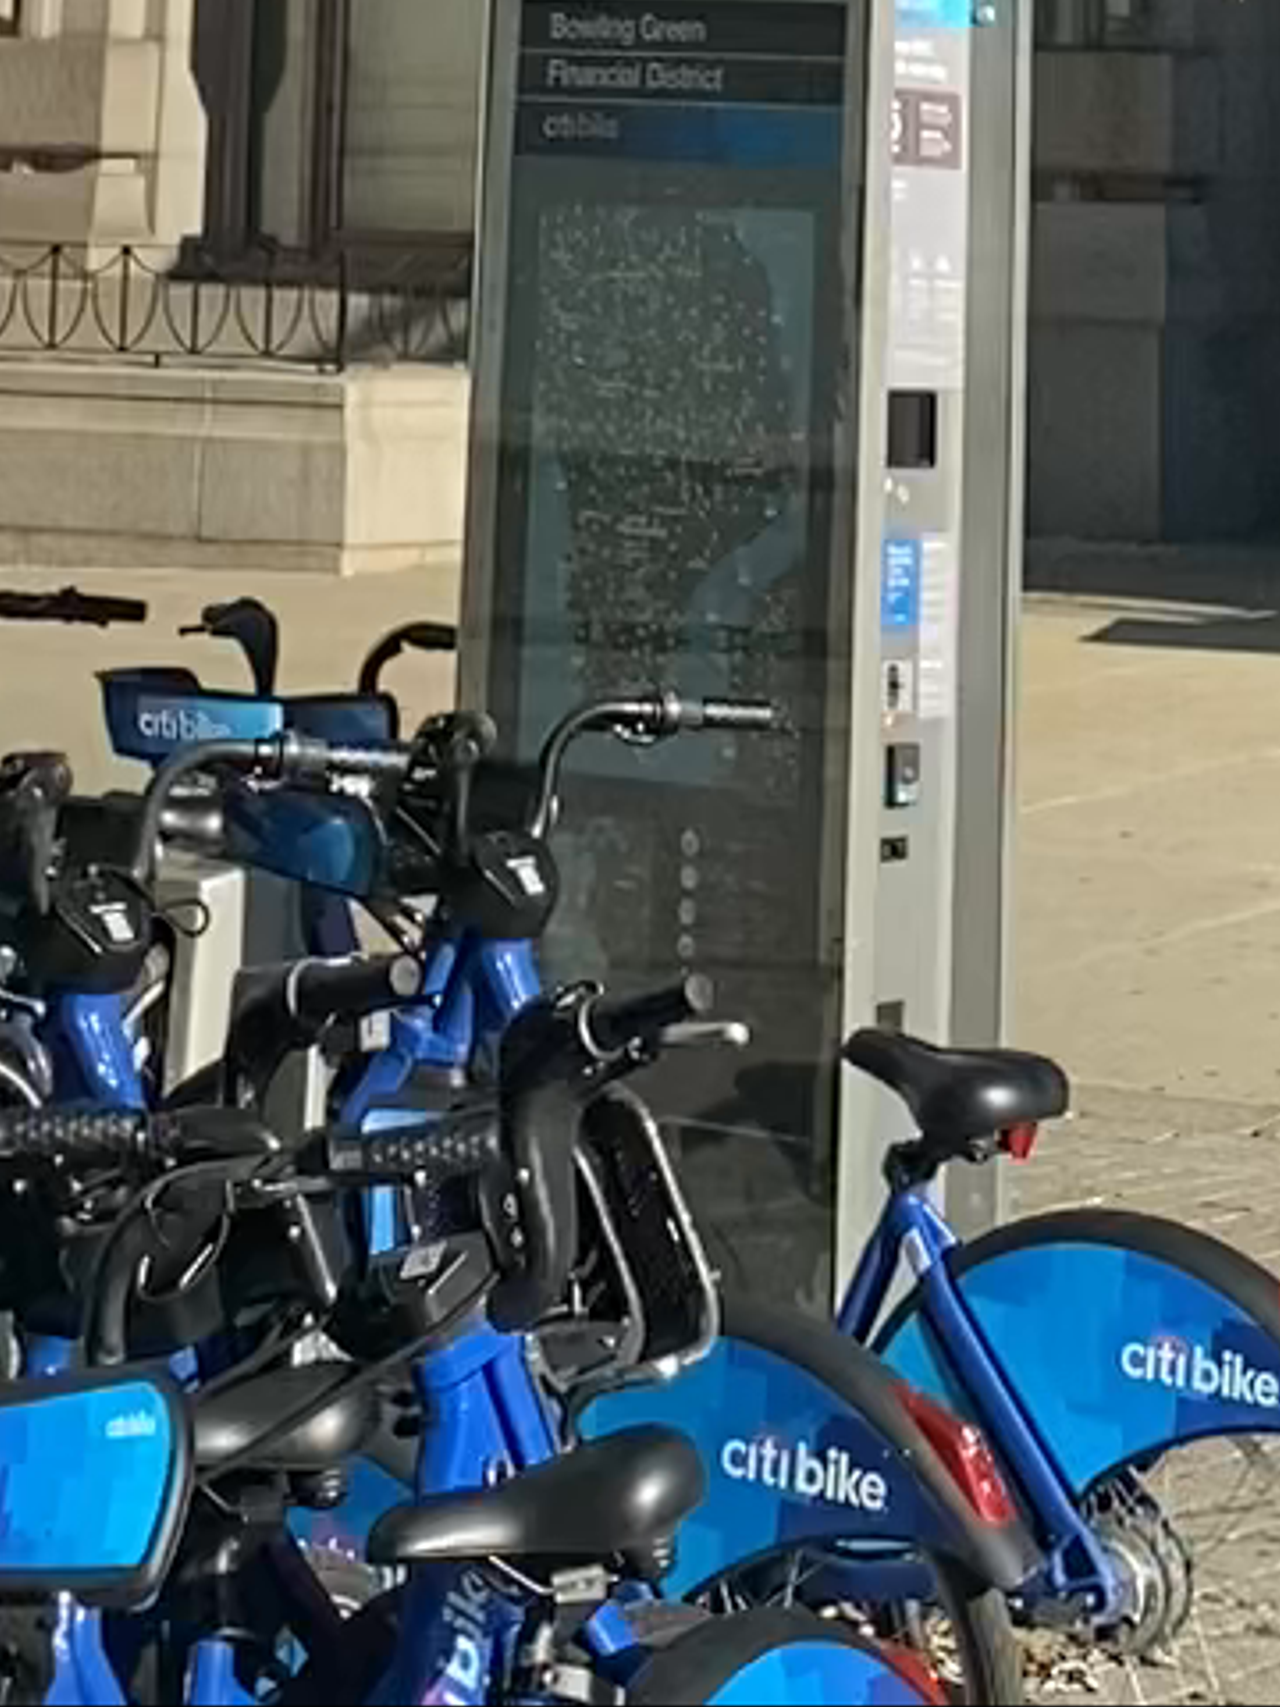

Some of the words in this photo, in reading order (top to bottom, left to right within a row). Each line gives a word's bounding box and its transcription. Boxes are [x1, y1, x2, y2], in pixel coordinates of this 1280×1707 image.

[549, 12, 636, 46] Bowling
[640, 13, 707, 43] Green
[547, 59, 641, 89] Financial
[645, 62, 723, 93] District
